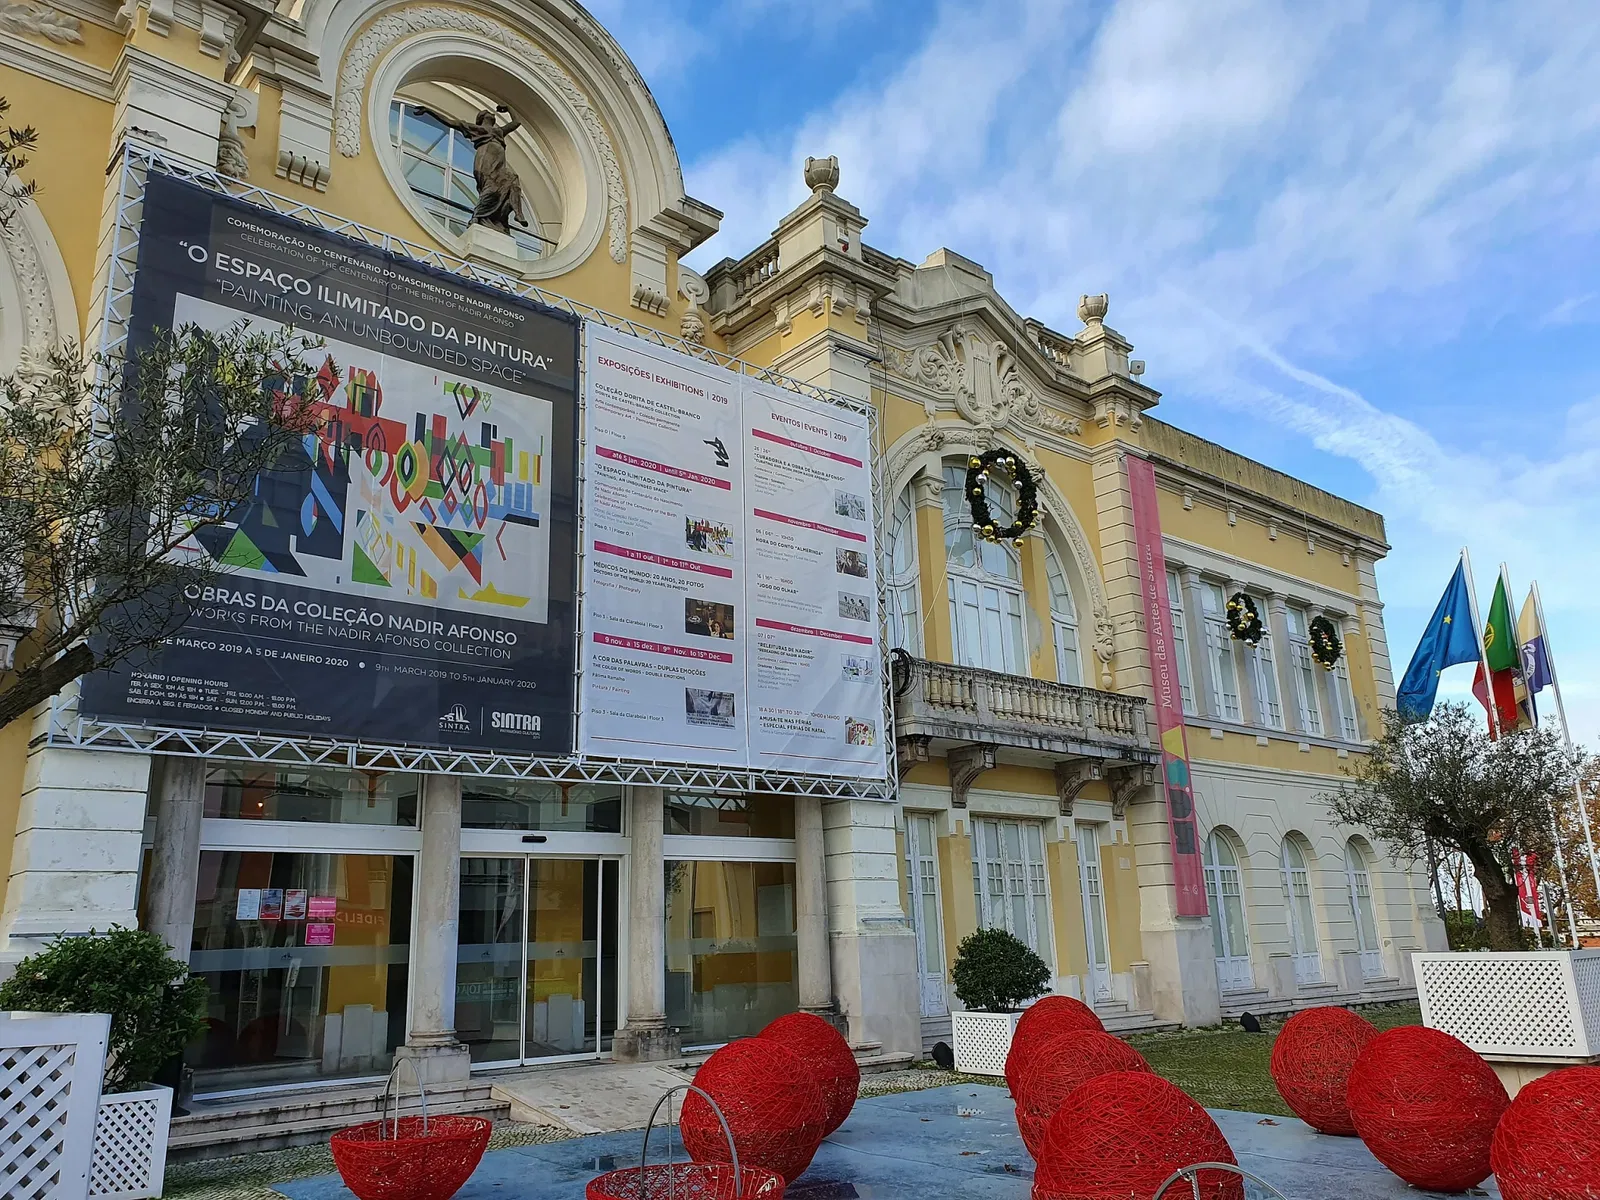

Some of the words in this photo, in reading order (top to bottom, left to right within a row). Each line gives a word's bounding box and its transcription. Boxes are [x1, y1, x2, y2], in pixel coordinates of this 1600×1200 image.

[227, 217, 305, 248] COMEMORAÇÃO
[307, 243, 322, 254] DO
[323, 249, 381, 274] CENTENÁRIO
[383, 269, 397, 279] DO
[398, 274, 452, 297] NASCIMENTO
[453, 292, 465, 302] DE
[466, 297, 492, 311] NADIR
[492, 306, 525, 322] AFONSO
[240, 233, 304, 260] CELEBRATION
[305, 254, 319, 263] OF
[320, 258, 337, 271] THE
[338, 265, 390, 287] CENTENARY
[390, 282, 403, 291] OF
[404, 286, 420, 298] THE
[421, 292, 445, 305] BIRTH
[445, 300, 457, 309] OF
[458, 304, 482, 318] NADIR
[482, 313, 515, 328] AFONSO
[179, 240, 208, 263] “O
[215, 252, 312, 296] ESPAÇO
[318, 284, 426, 332] ILIMITADO
[431, 321, 460, 344] DA
[464, 331, 553, 371] PINTURA”
[318, 312, 348, 332] AN
[352, 320, 468, 367] UNBOUNDED
[471, 357, 526, 385] SPACE”
[598, 356, 651, 380] EXPOSIÇÕES
[655, 374, 704, 397] EXHIBITIONS
[711, 393, 728, 405] 2019
[595, 382, 623, 396] COLEÇÃO
[623, 392, 646, 404] DORITA
[655, 402, 701, 420] CASTEL-BRANCO
[771, 412, 801, 428] EVENTOS
[804, 423, 828, 437] EVENTS
[834, 432, 847, 443] 2019
[611, 452, 623, 462] até
[623, 454, 628, 462] 5
[640, 460, 657, 470] 2020
[664, 464, 678, 475] until
[687, 470, 699, 481] Jan.
[700, 475, 716, 485] 2020
[593, 560, 619, 572] MÉDICOS
[619, 566, 628, 574] DO
[628, 569, 651, 578] MUNDO:
[660, 575, 678, 585] ANOS,
[685, 580, 705, 589] FOTOS
[642, 554, 654, 564] out.
[689, 563, 703, 574] Out.
[1148, 583, 1158, 601] de
[184, 583, 256, 608] OBRAS
[261, 595, 290, 614] DA
[293, 601, 384, 627] COLEÇÃO
[388, 614, 444, 636] NADIR
[447, 624, 517, 645] AFONSO
[1152, 600, 1164, 637] Artes
[176, 637, 216, 650] MARÇO
[218, 643, 243, 654] 2019
[244, 646, 253, 655] A
[255, 647, 262, 656] 5
[264, 649, 278, 658] DE
[280, 651, 323, 664] JANEIRO
[325, 657, 349, 667] 2020
[250, 614, 292, 630] FROM
[296, 620, 324, 635] THE
[328, 624, 371, 642] NADIR
[374, 632, 430, 649] AFONSO
[434, 640, 511, 660] COLLECTION
[610, 638, 624, 646] nov.
[641, 642, 655, 651] dez.
[673, 647, 687, 656] Nov.
[708, 652, 722, 663] Dec.
[1154, 639, 1167, 663] das
[170, 675, 203, 685] OPENING
[204, 679, 229, 688] HOURS
[394, 665, 427, 676] MARCH
[428, 669, 447, 679] 2019
[449, 671, 461, 681] TO
[476, 676, 516, 686] JANUARY
[516, 679, 537, 689] 2020
[610, 657, 623, 665] DAS
[623, 659, 653, 669] PALAVRAS
[657, 664, 680, 673] DUPLAS
[679, 667, 706, 677] EMOÇÕES
[1160, 664, 1173, 709] Museu
[438, 721, 470, 733] SINTRA
[491, 711, 541, 731] SINTRA
